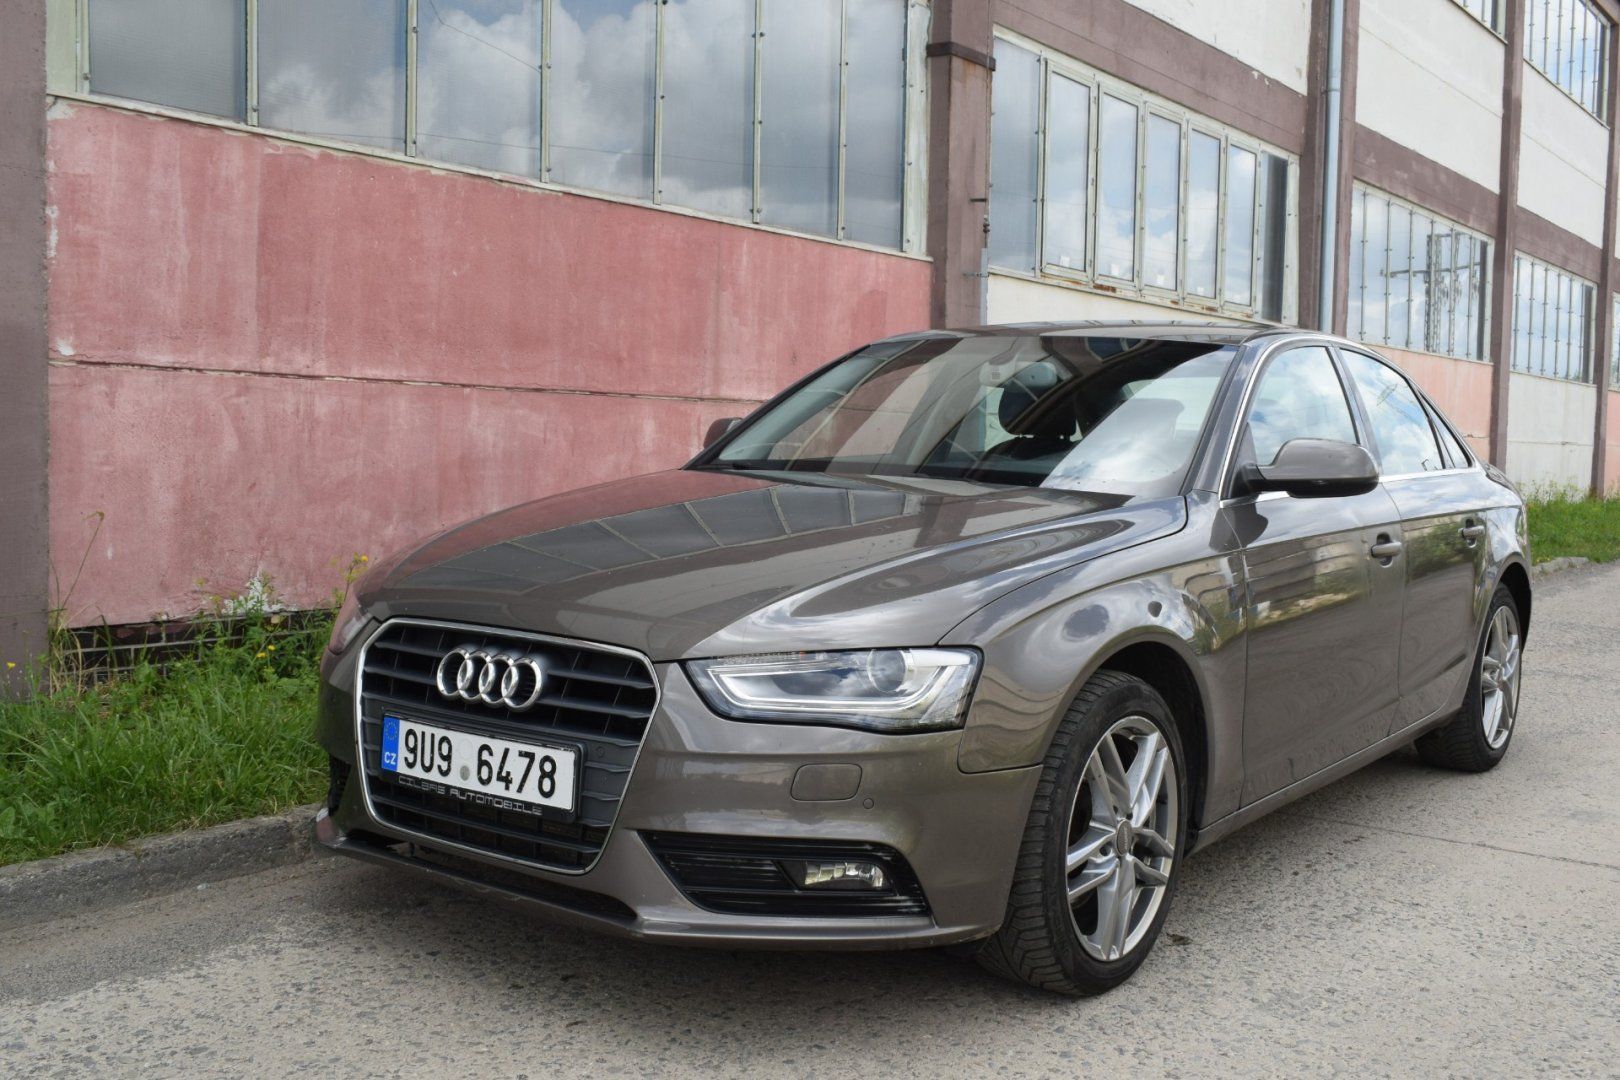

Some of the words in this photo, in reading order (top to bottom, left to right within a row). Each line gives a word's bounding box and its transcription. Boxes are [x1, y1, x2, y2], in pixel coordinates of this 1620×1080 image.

[384, 751, 397, 765] CZ
[404, 728, 453, 777] 9U9
[476, 743, 557, 799] 6478
[449, 788, 543, 816] AUTOMOBILE
